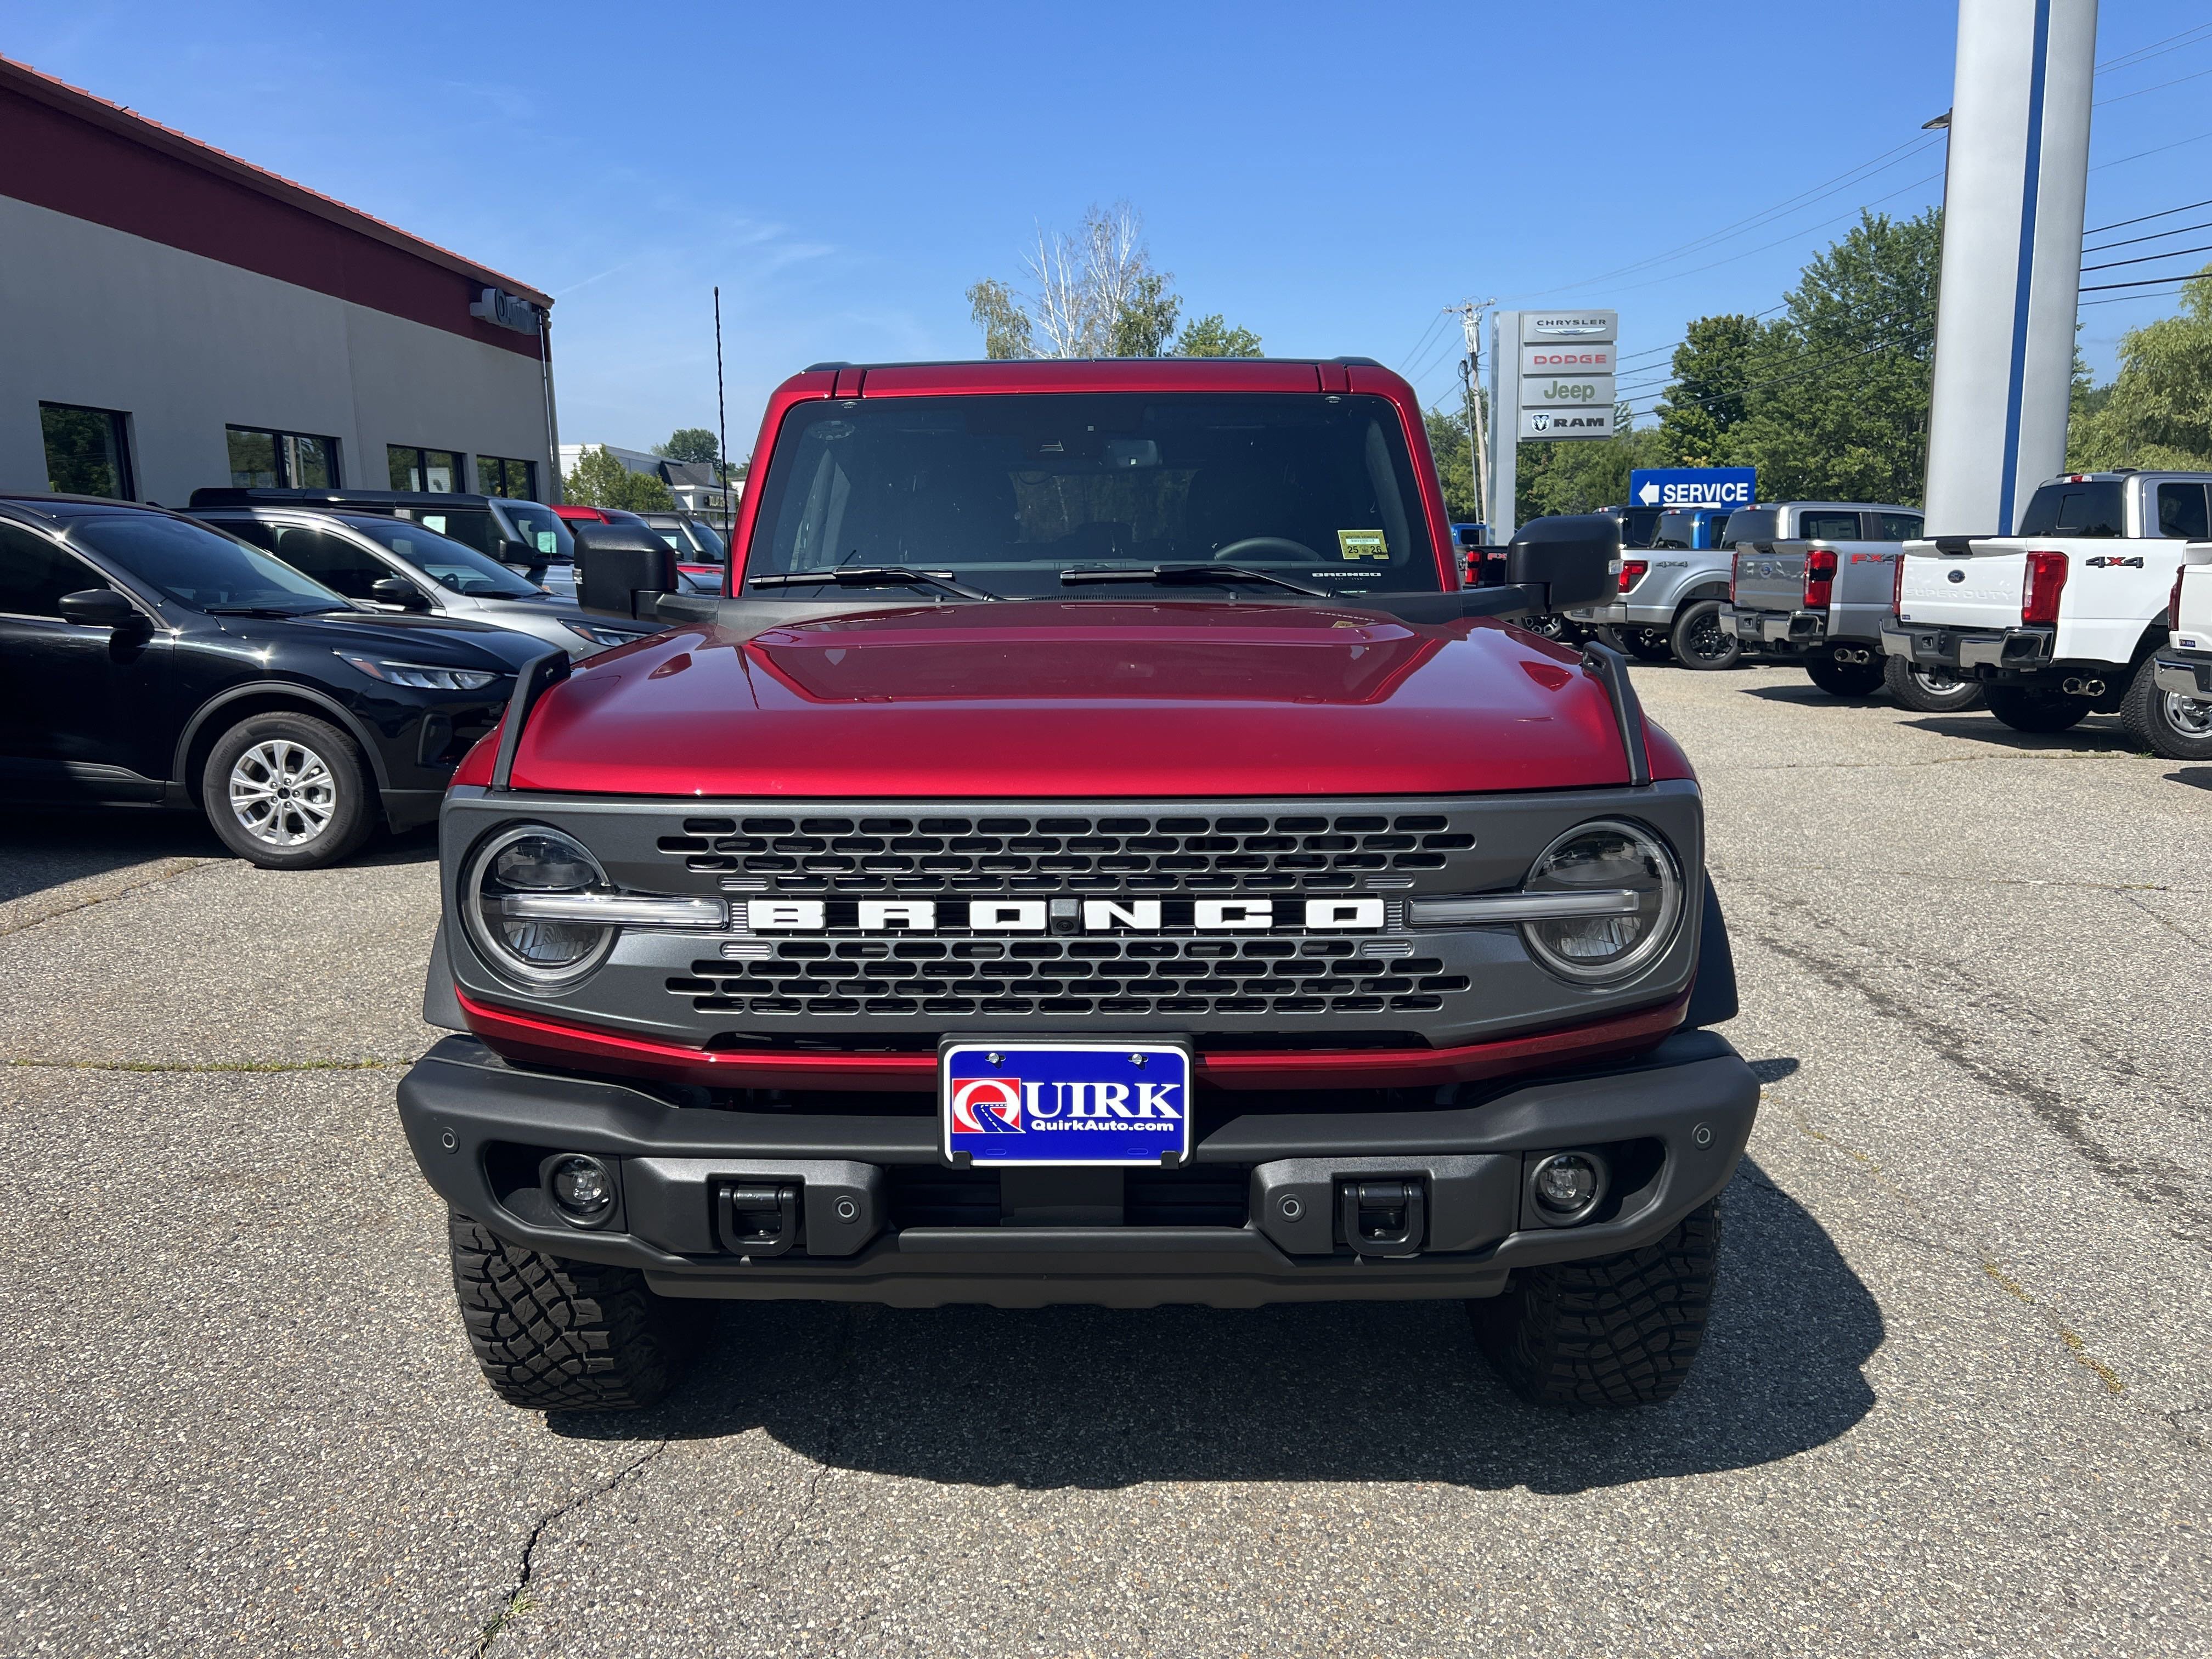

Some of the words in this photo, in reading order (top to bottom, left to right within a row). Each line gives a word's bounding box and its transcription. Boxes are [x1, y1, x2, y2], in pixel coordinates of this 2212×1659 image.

[1534, 354, 1606, 365] DODGE
[1544, 381, 1595, 402] Jeep
[1554, 417, 1605, 427] RAM
[1663, 483, 1748, 503] SERVICE
[1850, 553, 1898, 565] FX4
[1905, 588, 1958, 598] SUPER
[1963, 589, 2014, 600] DUTY
[748, 900, 1384, 930] BRONCO
[953, 1079, 1183, 1133] QUIRK
[1031, 1120, 1174, 1132] QuirkAuto.com
